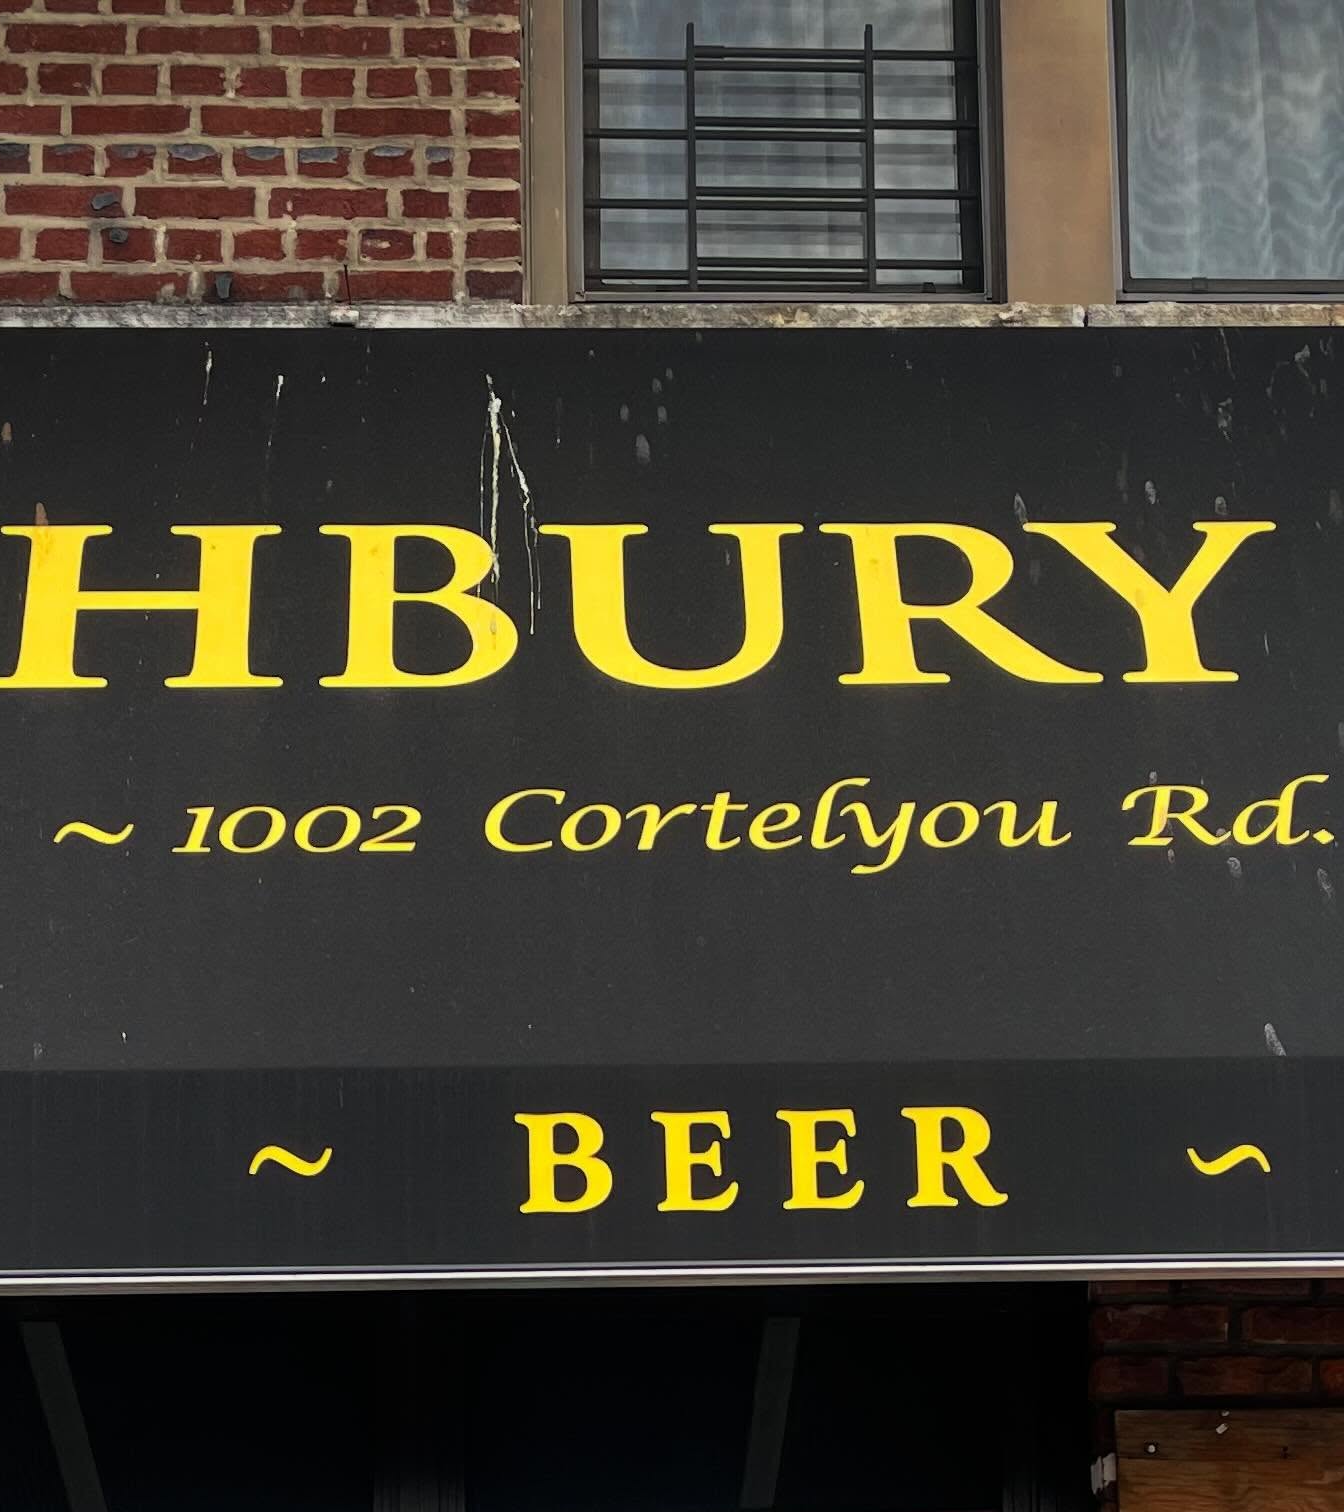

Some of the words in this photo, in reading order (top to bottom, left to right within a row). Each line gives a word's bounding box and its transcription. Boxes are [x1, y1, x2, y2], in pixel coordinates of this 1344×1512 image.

[177, 805, 421, 853] 1002
[485, 778, 1069, 874] Cortelyou
[1123, 775, 1333, 848] Rd.
[515, 1107, 1008, 1213] BEER
